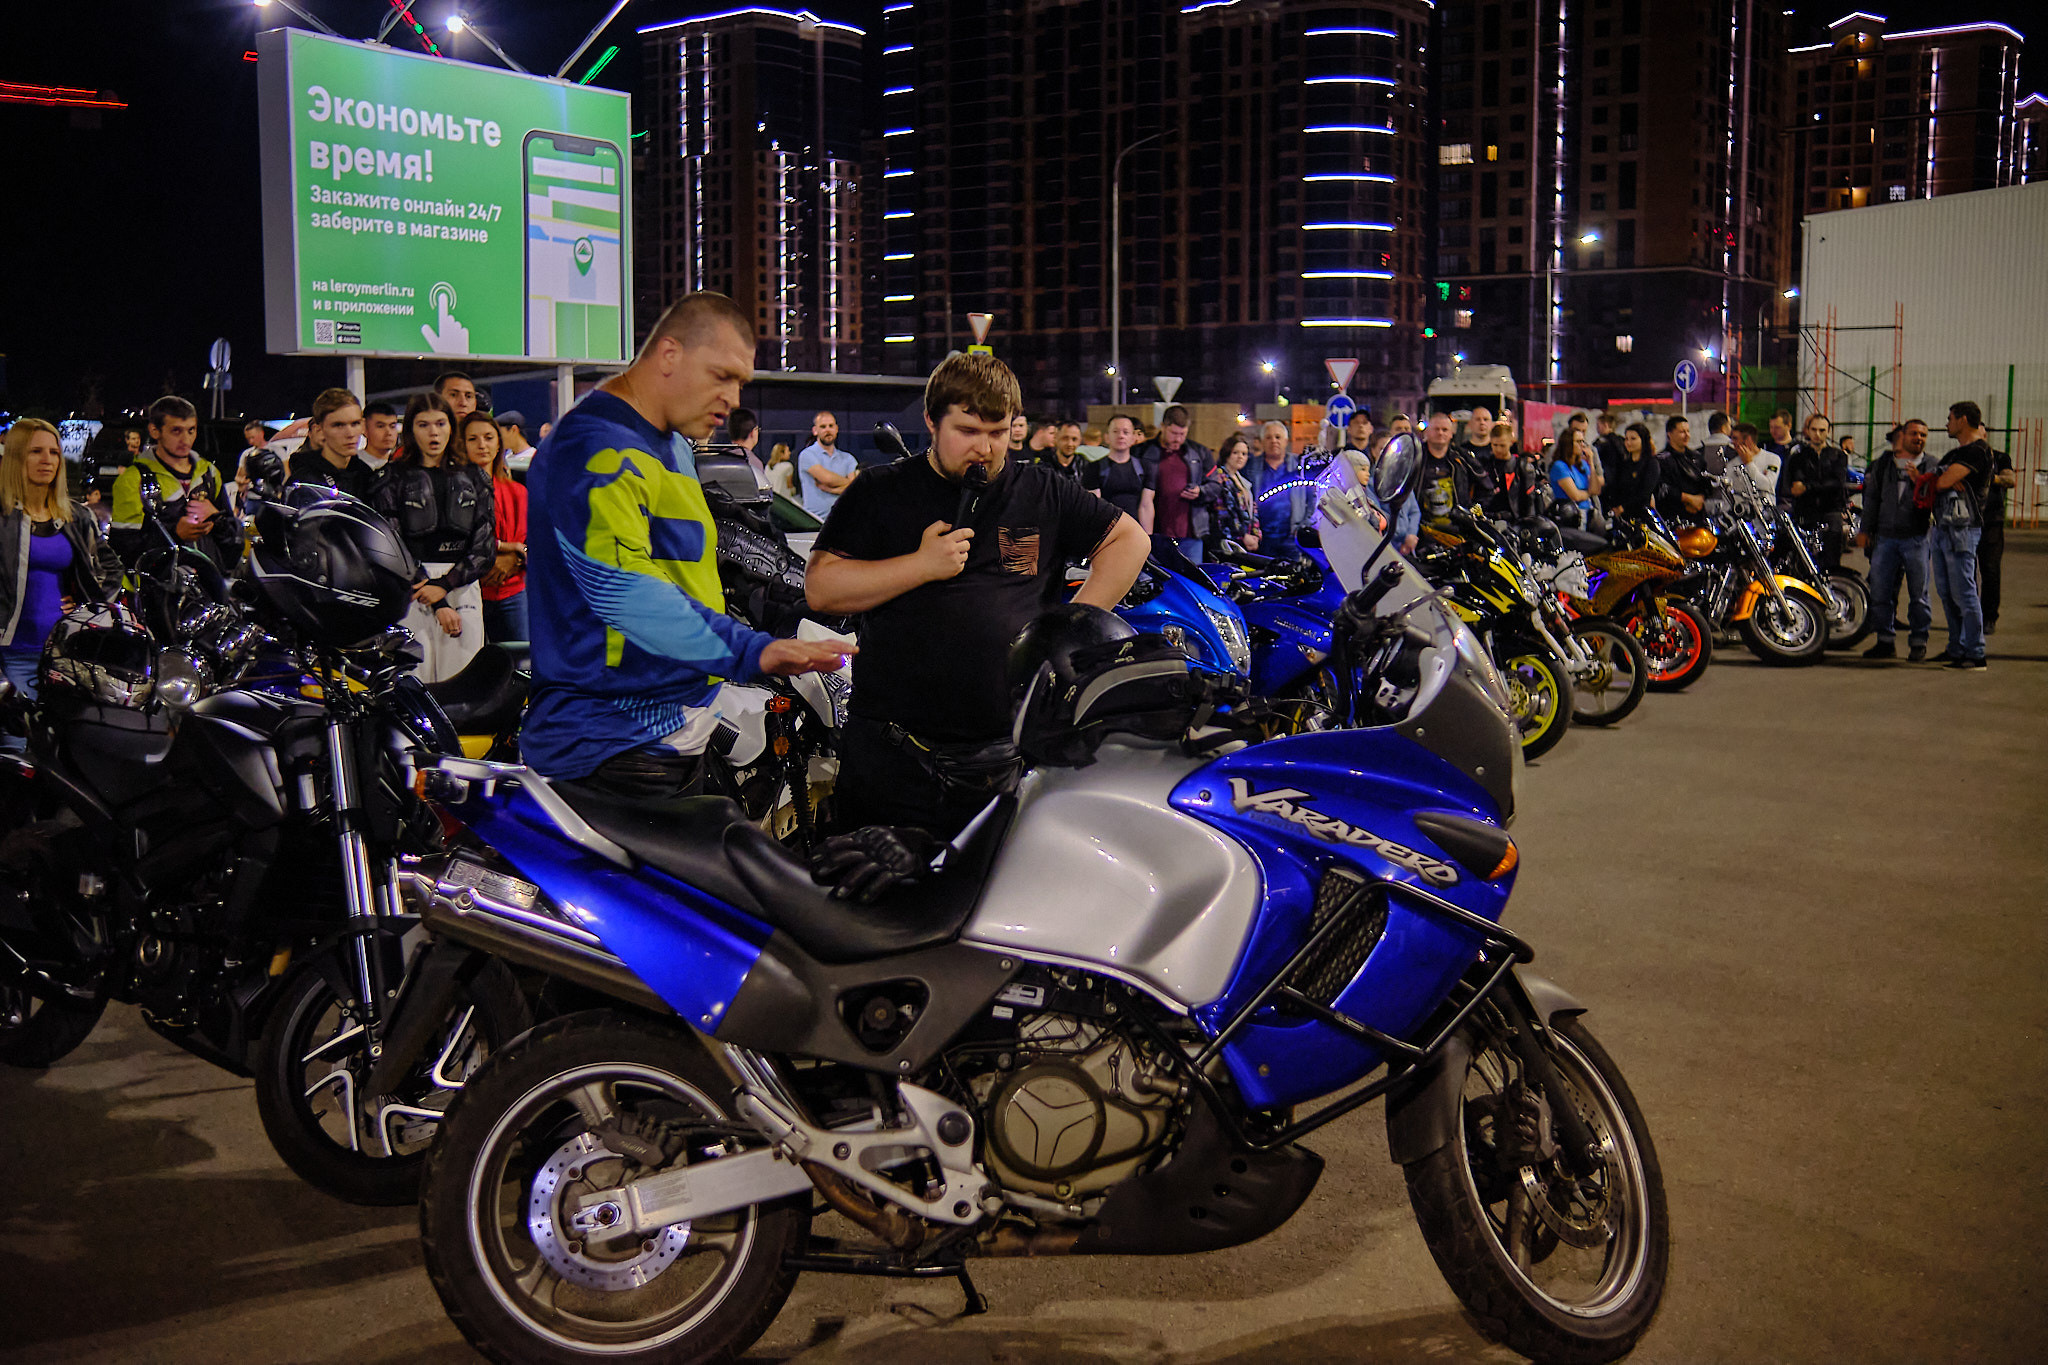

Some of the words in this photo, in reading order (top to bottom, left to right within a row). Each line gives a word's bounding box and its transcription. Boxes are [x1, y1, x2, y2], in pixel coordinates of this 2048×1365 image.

[307, 85, 502, 148] Экономьте
[310, 140, 434, 183] время!
[310, 185, 401, 212] Закажите
[403, 196, 465, 220] онлайн
[468, 202, 502, 223] 24/7
[311, 211, 394, 236] заберите
[397, 221, 407, 236] в
[410, 222, 489, 244] магазине
[312, 280, 328, 292] на
[330, 278, 415, 298] leroymerlin.ru
[313, 299, 322, 311] и
[324, 300, 333, 312] в
[334, 300, 415, 316] приложении
[1228, 777, 1459, 890] VARADERO
